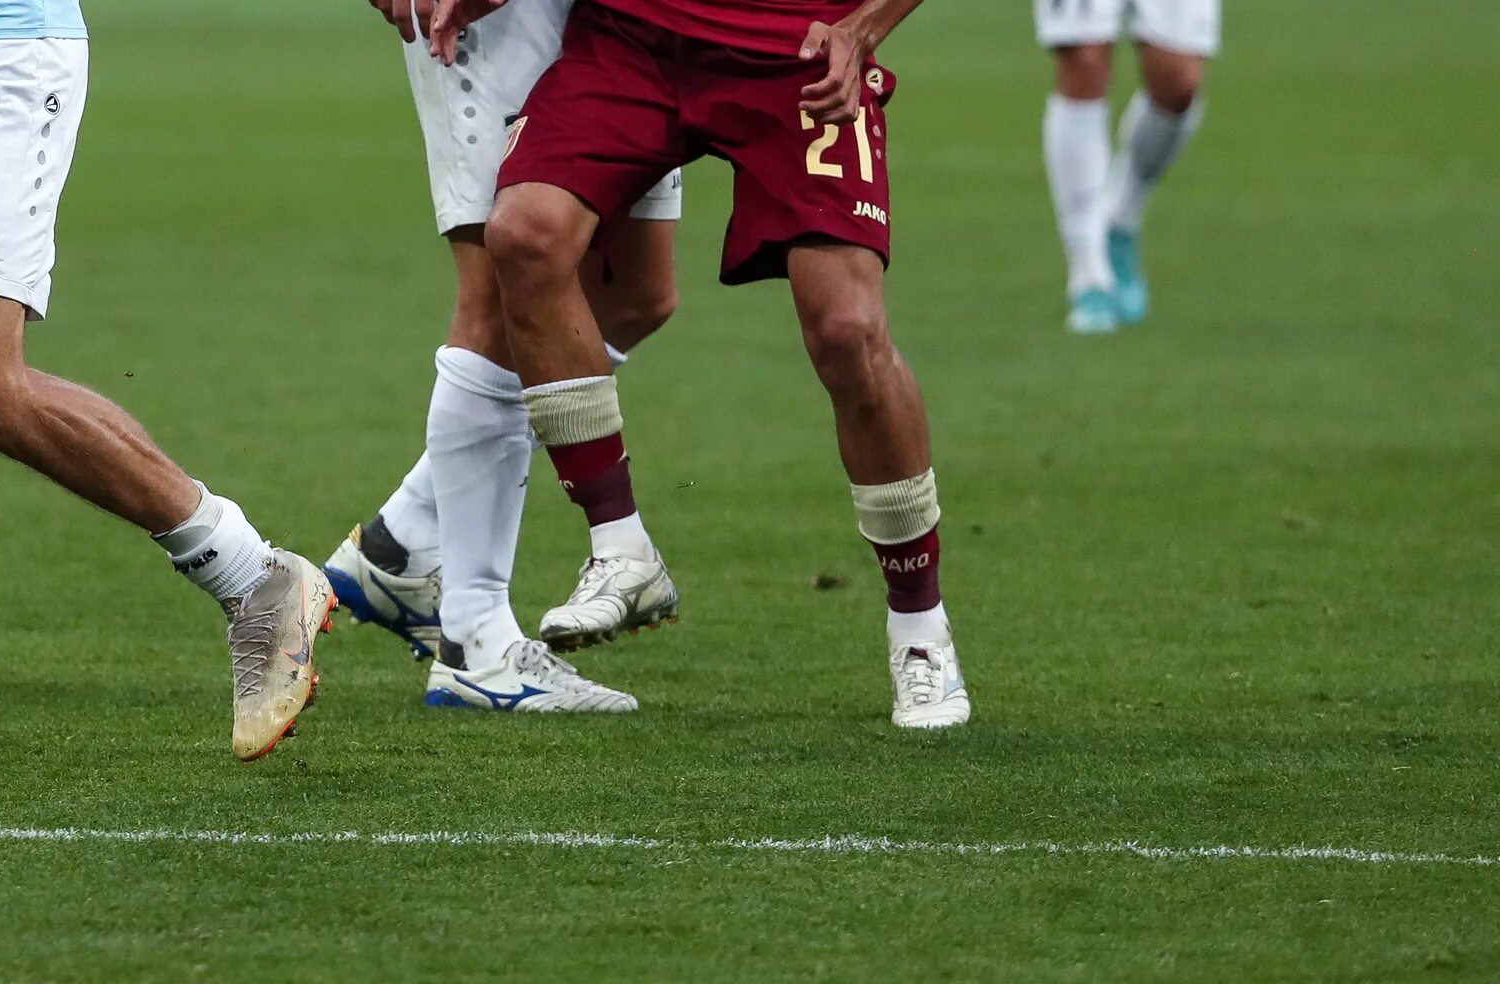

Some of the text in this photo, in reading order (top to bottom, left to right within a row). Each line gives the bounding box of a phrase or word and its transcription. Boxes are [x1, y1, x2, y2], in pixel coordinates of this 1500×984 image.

[800, 106, 874, 183] 21
[852, 200, 887, 225] JAKO
[882, 552, 930, 573] JAKO
